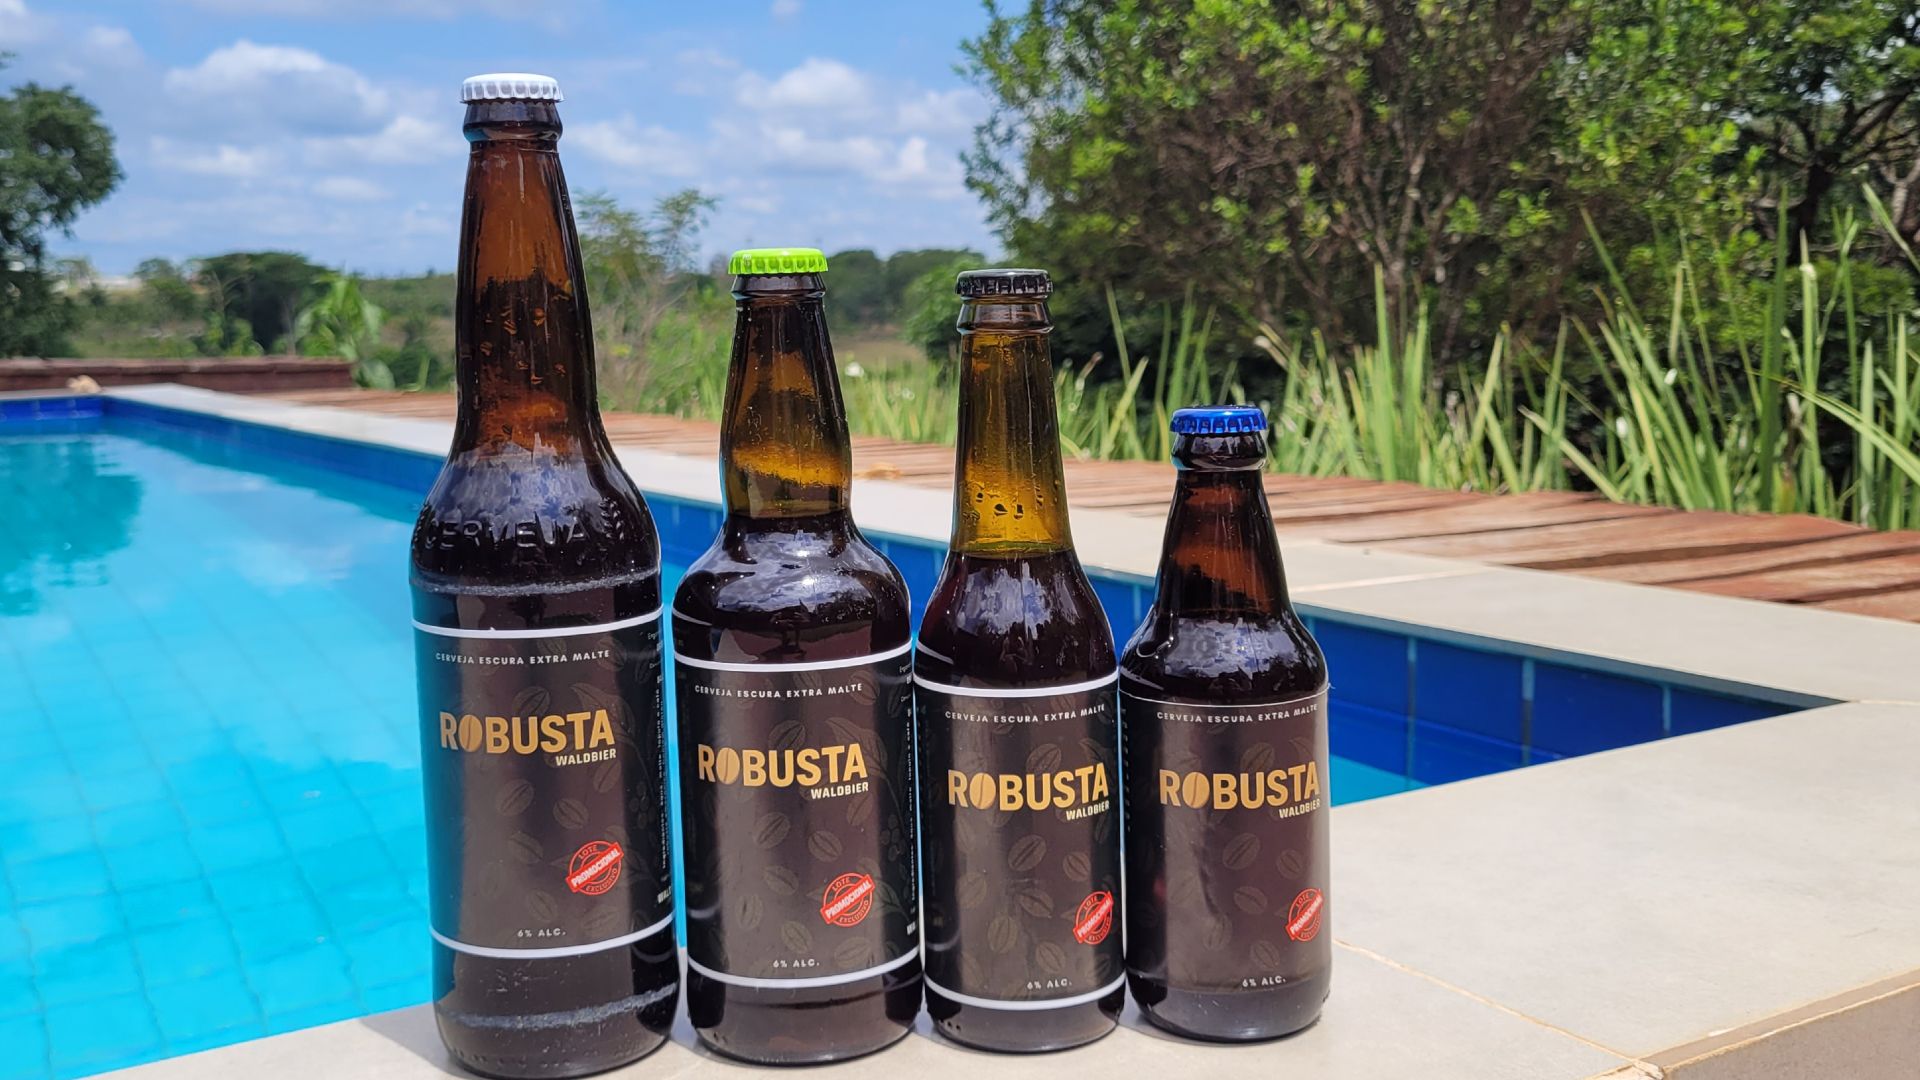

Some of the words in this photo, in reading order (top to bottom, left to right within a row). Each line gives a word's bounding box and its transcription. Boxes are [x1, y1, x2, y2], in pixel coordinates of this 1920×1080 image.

[435, 652, 475, 665] CERVEJA
[479, 656, 525, 665] ESCURA
[529, 654, 569, 665] EXTRA
[572, 650, 610, 662] MALTE
[694, 685, 732, 697] CERVEJA
[737, 690, 781, 698] ESCURA
[786, 687, 823, 697] EXTRA
[827, 683, 863, 695] MALTE
[945, 710, 988, 723] CERVEJA
[993, 715, 1039, 723] ESCURA
[1044, 710, 1077, 722] EXTRA
[1080, 703, 1105, 717] MALTE
[1156, 711, 1202, 723] CERVEJA
[1207, 715, 1253, 723] ESCURA
[1258, 711, 1290, 722] EXTRA
[1293, 703, 1318, 717] MALTE
[439, 709, 616, 755] ROBUSTA
[555, 748, 617, 767] WALDBIER
[697, 743, 868, 788] ROBUSTA
[810, 782, 869, 800] WALDBIER
[947, 762, 1109, 811] ROBUSTA
[1159, 761, 1320, 810] ROBUSTA
[1066, 800, 1110, 821] WALDBIER
[1279, 798, 1321, 819] WALDBIER
[517, 929, 532, 938] 6%
[773, 959, 788, 968] 6%
[1242, 978, 1257, 988] 6%
